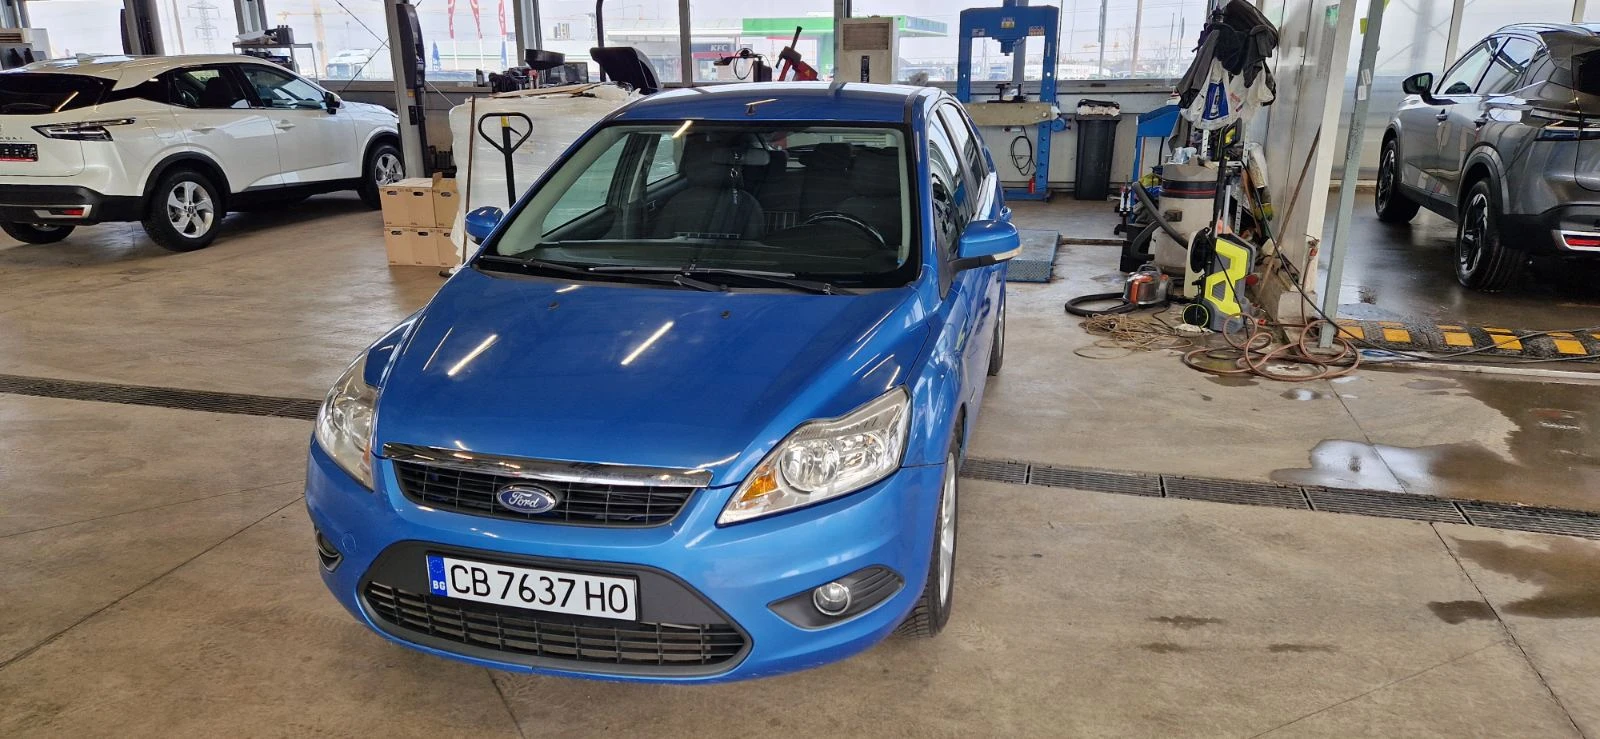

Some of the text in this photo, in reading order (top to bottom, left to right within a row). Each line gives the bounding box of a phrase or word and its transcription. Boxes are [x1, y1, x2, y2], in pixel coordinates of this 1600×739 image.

[710, 44, 728, 52] KFC
[508, 491, 540, 508] Ford
[433, 580, 446, 591] BG
[450, 564, 628, 613] CB 7637 HO
